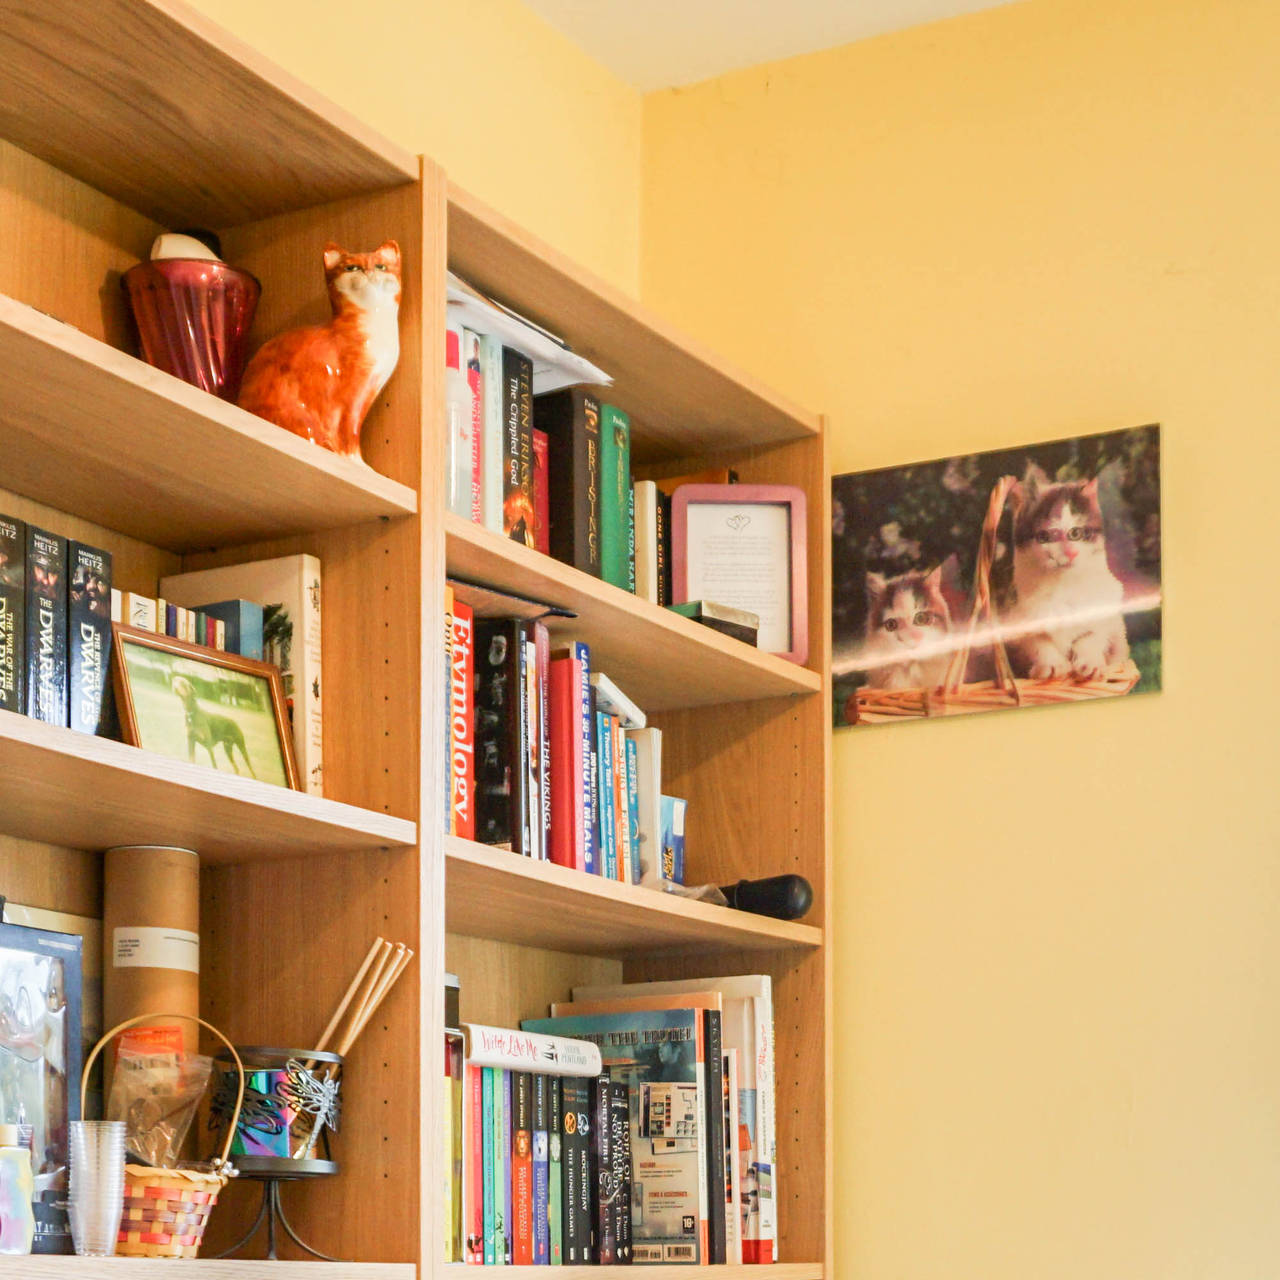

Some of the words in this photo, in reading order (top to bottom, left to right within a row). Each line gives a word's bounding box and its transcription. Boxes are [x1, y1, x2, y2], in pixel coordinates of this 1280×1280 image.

[510, 377, 519, 399] The
[520, 362, 530, 428] STEVEN
[509, 403, 519, 456] Crippled
[510, 459, 519, 485] God
[33, 533, 59, 547] MARKUS
[33, 540, 59, 556] HEITZ
[78, 549, 102, 563] MARKUS
[78, 555, 103, 571] HEITZ
[6, 612, 14, 631] THE
[6, 633, 14, 654] WAR
[6, 656, 14, 670] OF
[39, 608, 54, 714] DWARVES
[80, 622, 95, 725] DWARVES
[6, 672, 14, 691] THE
[580, 649, 589, 716] JAMIE'S
[452, 614, 472, 822] Etymology
[543, 740, 551, 769] THE
[581, 717, 592, 804] 30-MINUTE
[604, 731, 612, 766] Theory
[543, 772, 551, 830] VIKINGS
[583, 807, 592, 863] MEALS
[601, 1088, 609, 1138] MORTAL
[602, 1139, 610, 1164] FIRE
[622, 1121, 630, 1161] ROPE
